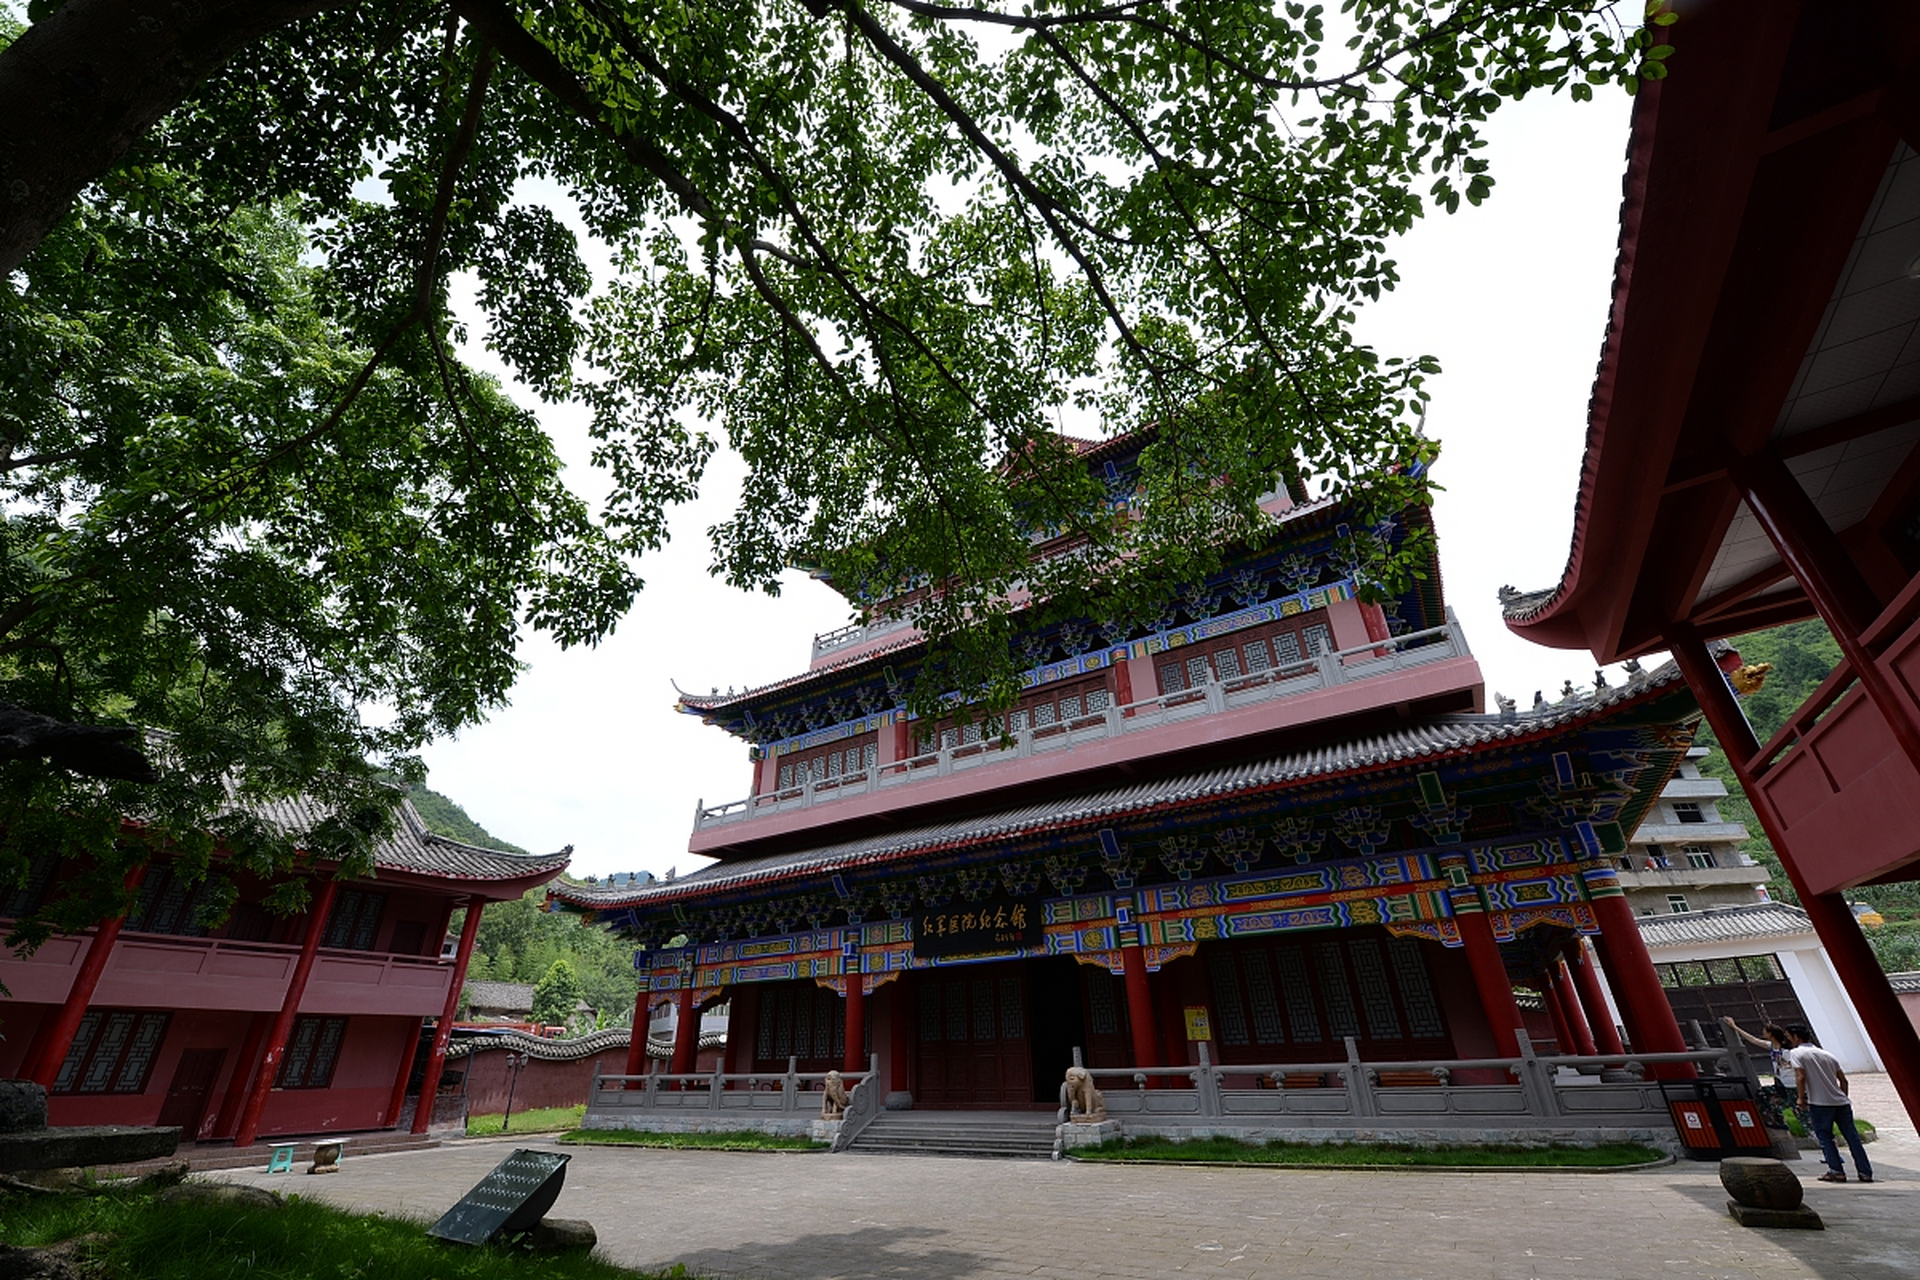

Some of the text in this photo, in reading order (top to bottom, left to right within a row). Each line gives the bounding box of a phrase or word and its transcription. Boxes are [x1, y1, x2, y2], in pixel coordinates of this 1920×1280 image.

[922, 903, 1027, 937] 红军医院纪念馆
